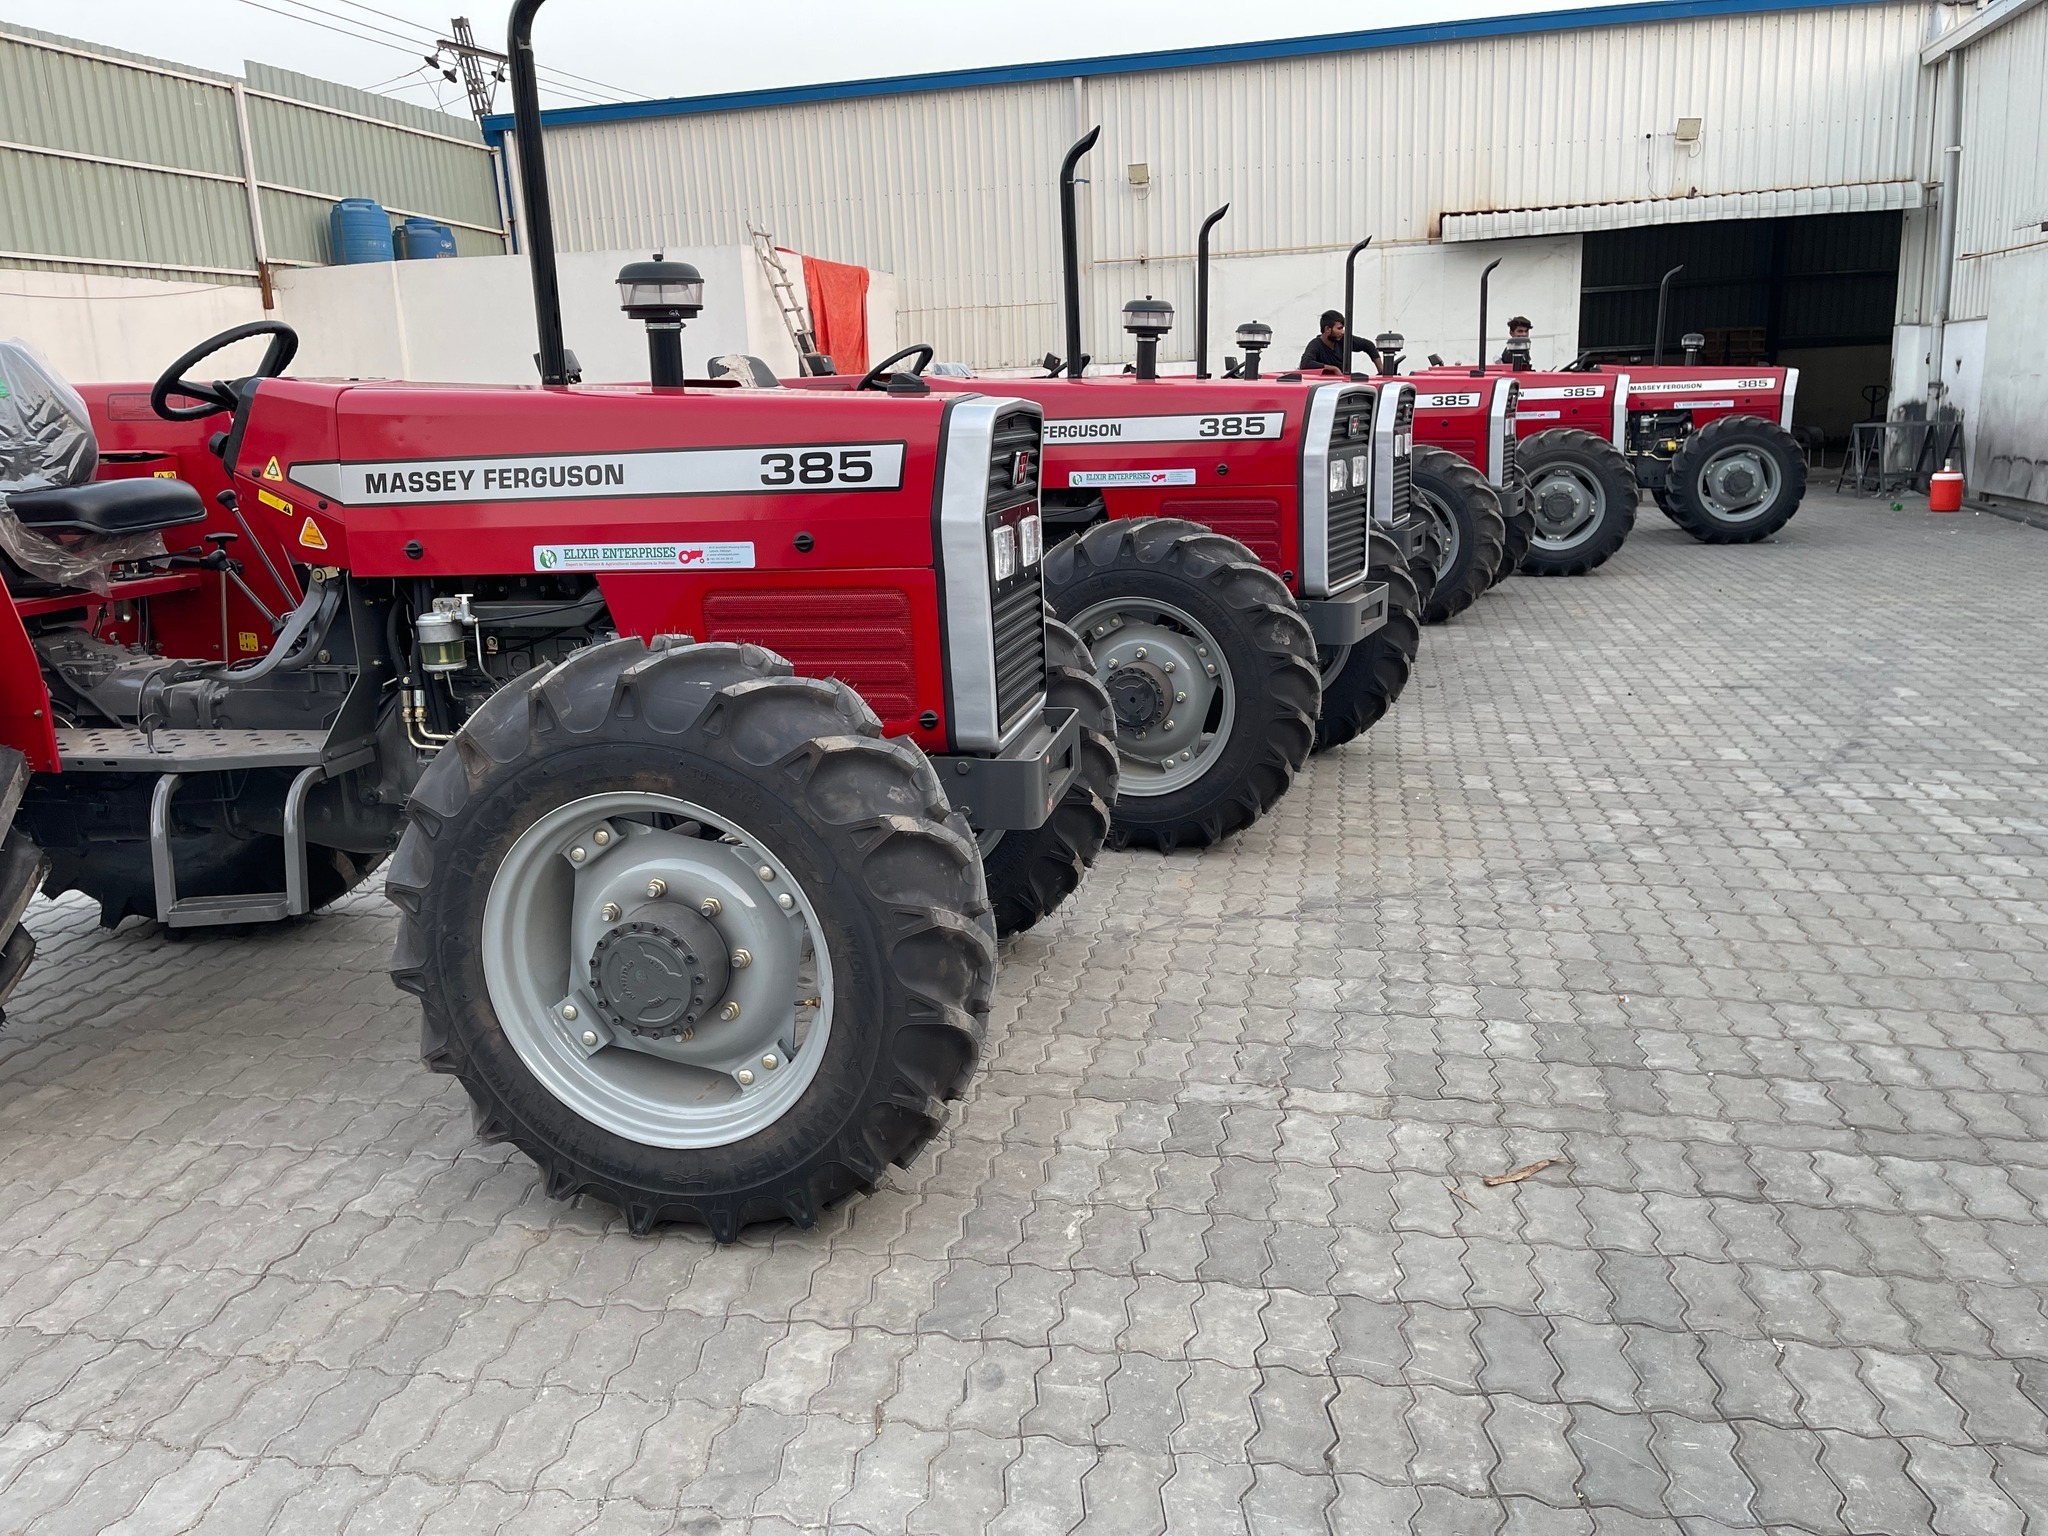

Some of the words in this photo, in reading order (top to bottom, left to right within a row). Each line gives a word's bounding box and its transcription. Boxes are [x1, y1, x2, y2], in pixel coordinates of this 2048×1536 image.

[1630, 384, 1661, 392] MASSEY
[1662, 382, 1702, 391] FERGUSON
[1737, 379, 1768, 389] 385
[1563, 387, 1596, 397] 385
[1432, 395, 1470, 406] 385
[1199, 416, 1265, 437] 385
[365, 469, 475, 494] MASSEY
[484, 463, 624, 490] FERGUSON
[760, 450, 873, 486] 385
[1086, 473, 1107, 481] ELIXIR
[1108, 472, 1151, 480] ENTERPRISES
[563, 548, 600, 559] ELIXIR
[602, 547, 676, 559] ENTERPRISES
